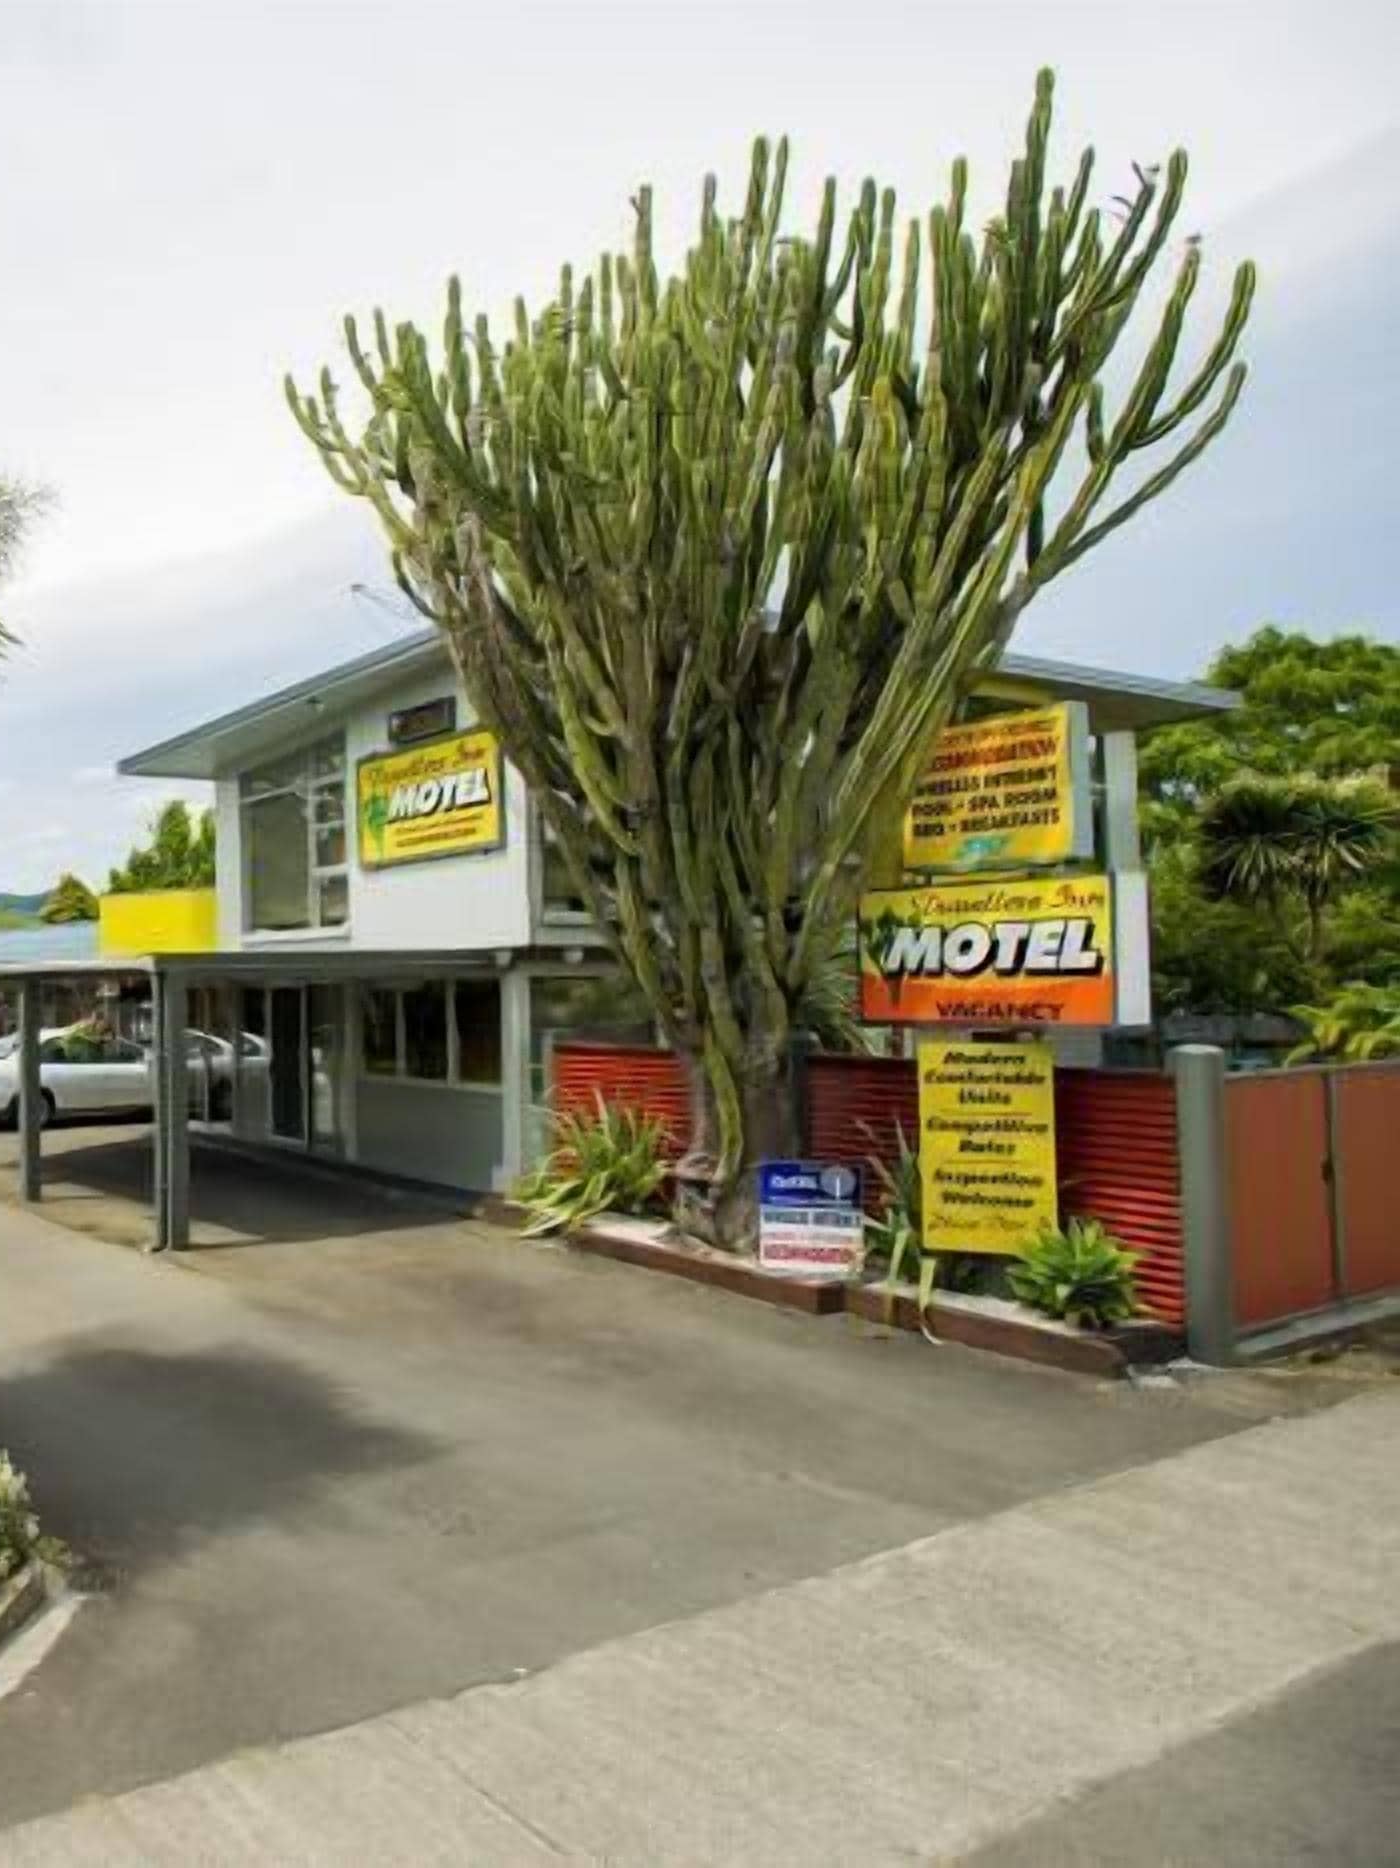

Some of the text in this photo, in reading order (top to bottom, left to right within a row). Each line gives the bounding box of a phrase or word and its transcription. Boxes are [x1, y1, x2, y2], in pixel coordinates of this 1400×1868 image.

[387, 767, 493, 824] MOTEL
[968, 795, 998, 813] SPA
[883, 917, 1104, 976] MOTEL
[936, 1002, 1065, 1021] VACANCY
